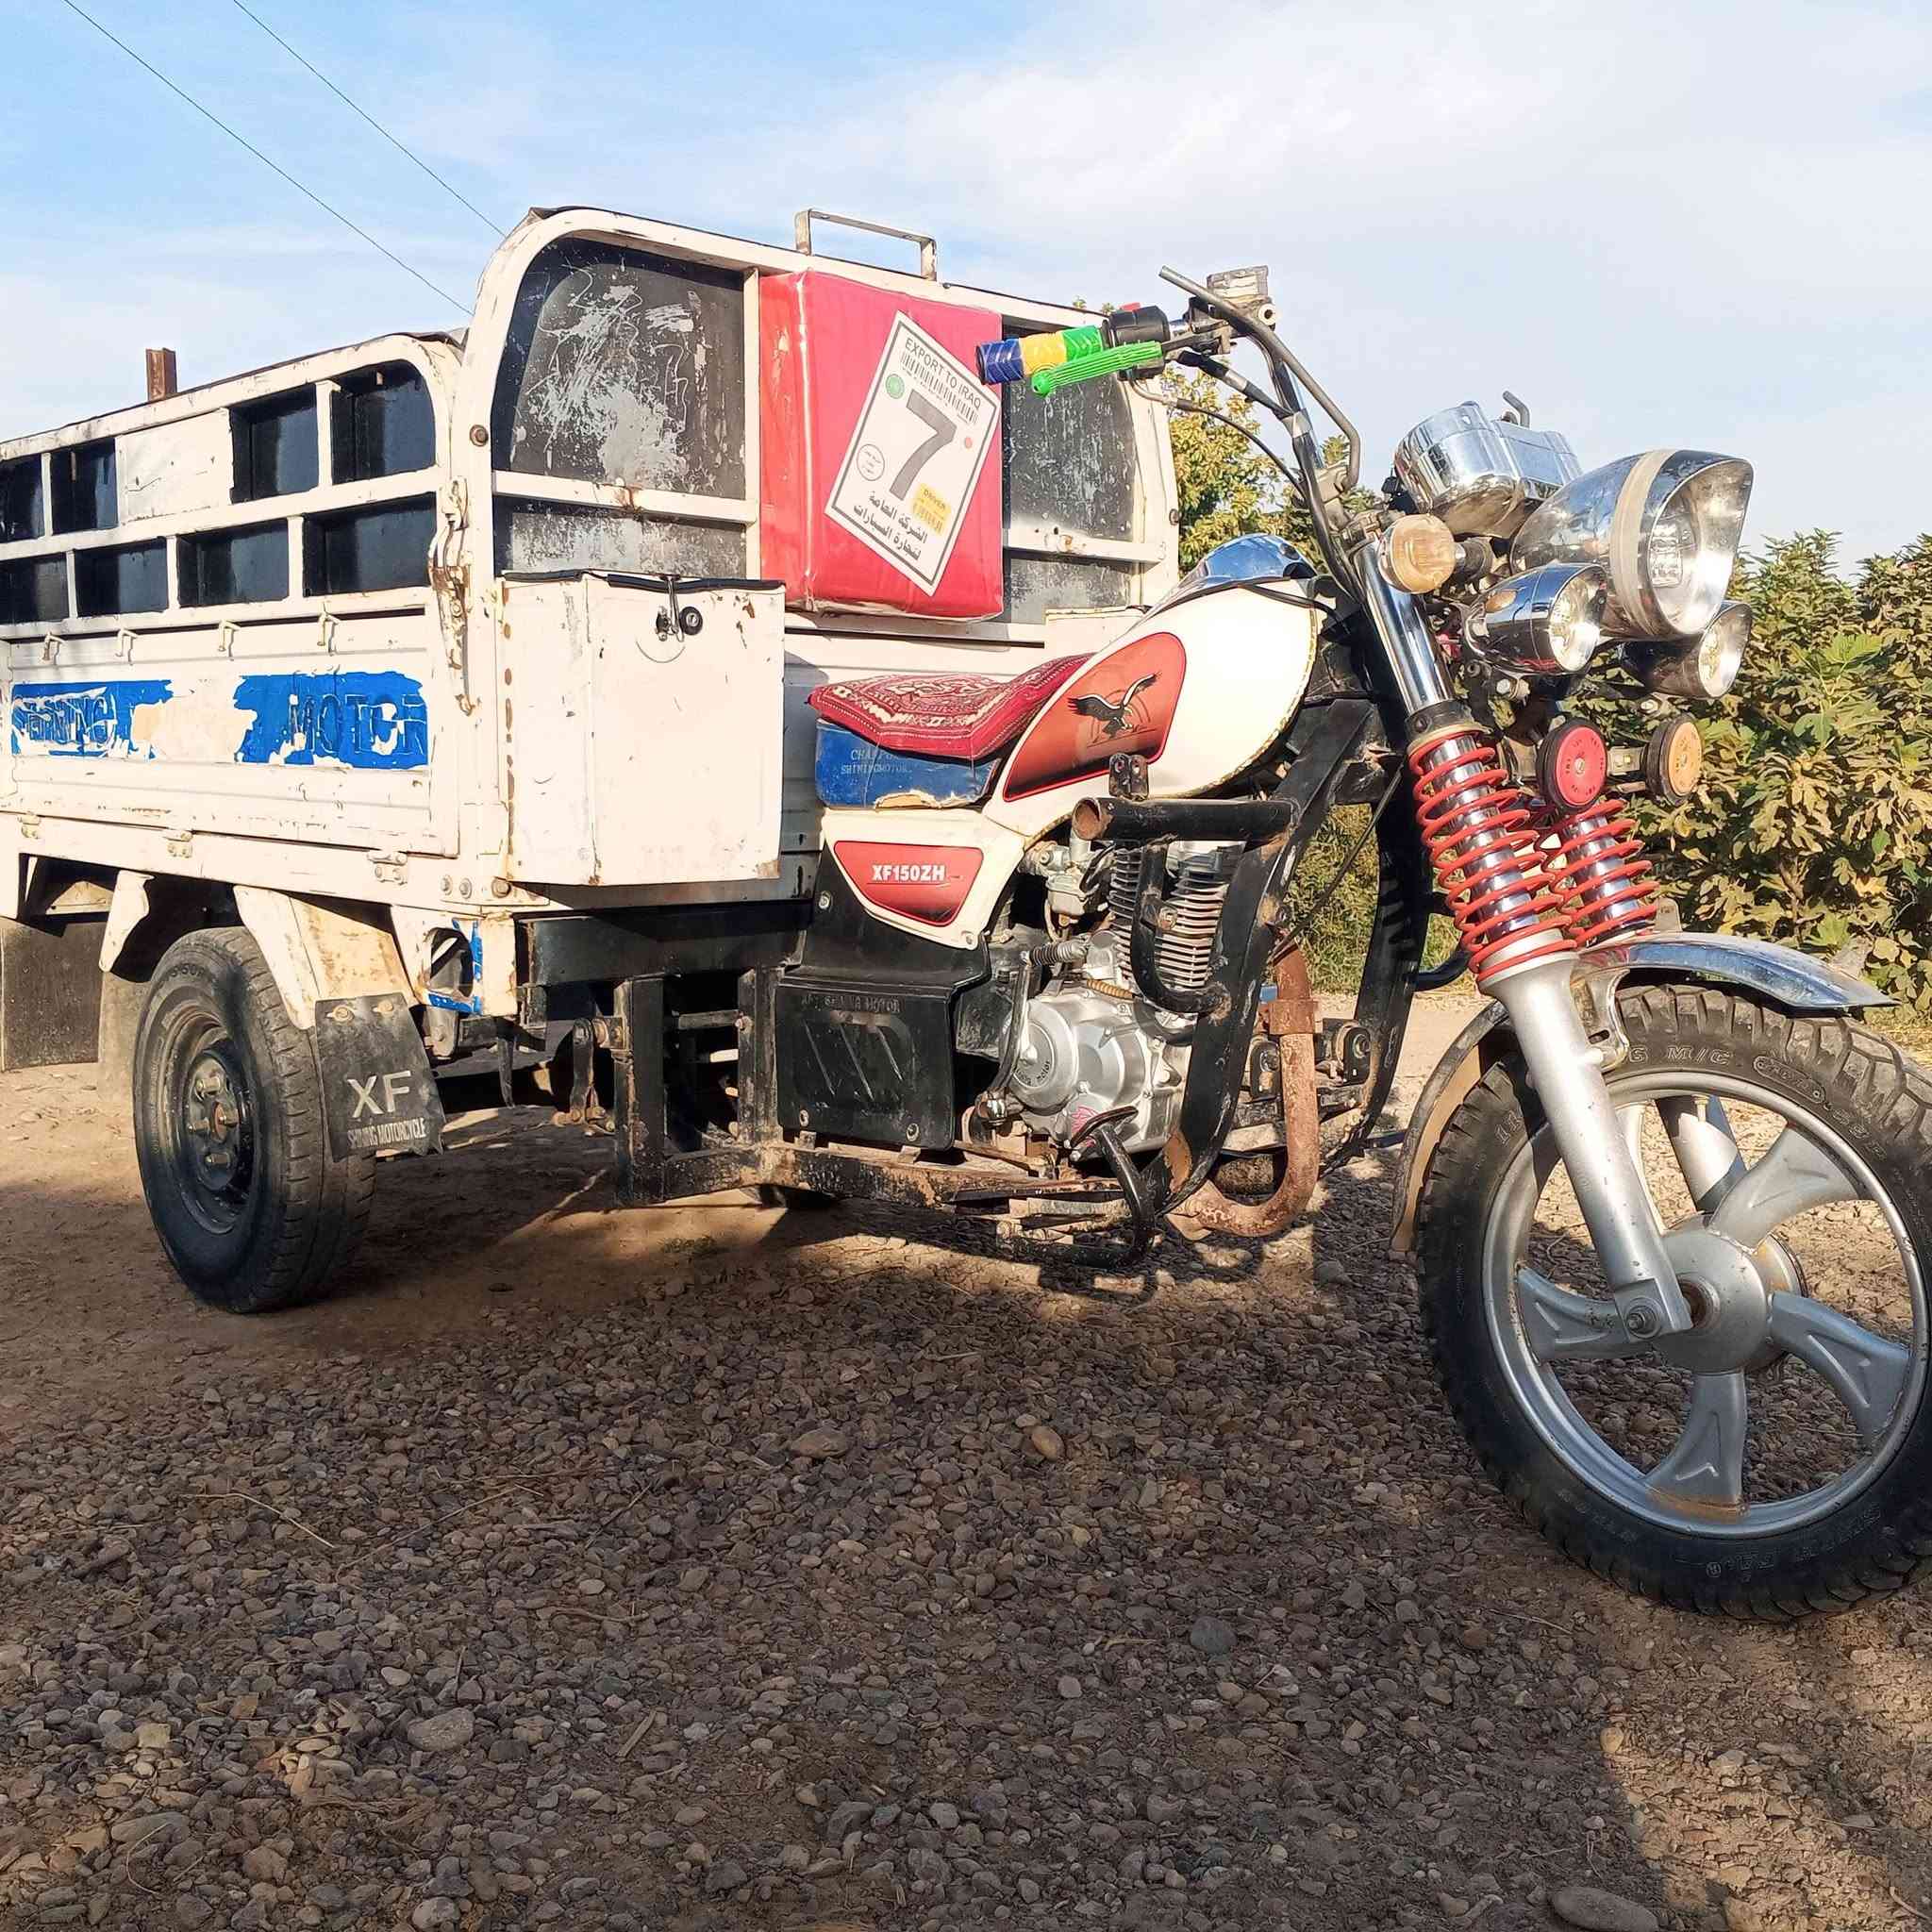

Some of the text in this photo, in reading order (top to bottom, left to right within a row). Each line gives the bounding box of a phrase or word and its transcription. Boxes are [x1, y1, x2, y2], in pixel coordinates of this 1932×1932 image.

[906, 338, 943, 375] EXPORT
[946, 371, 958, 388] TO
[958, 384, 981, 409] IRAQ
[889, 389, 957, 501] 7
[869, 490, 928, 543] الشركة العامة
[872, 864, 945, 882] XF150ZH
[1666, 1045, 1732, 1066] M/C
[347, 1070, 411, 1118] XF
